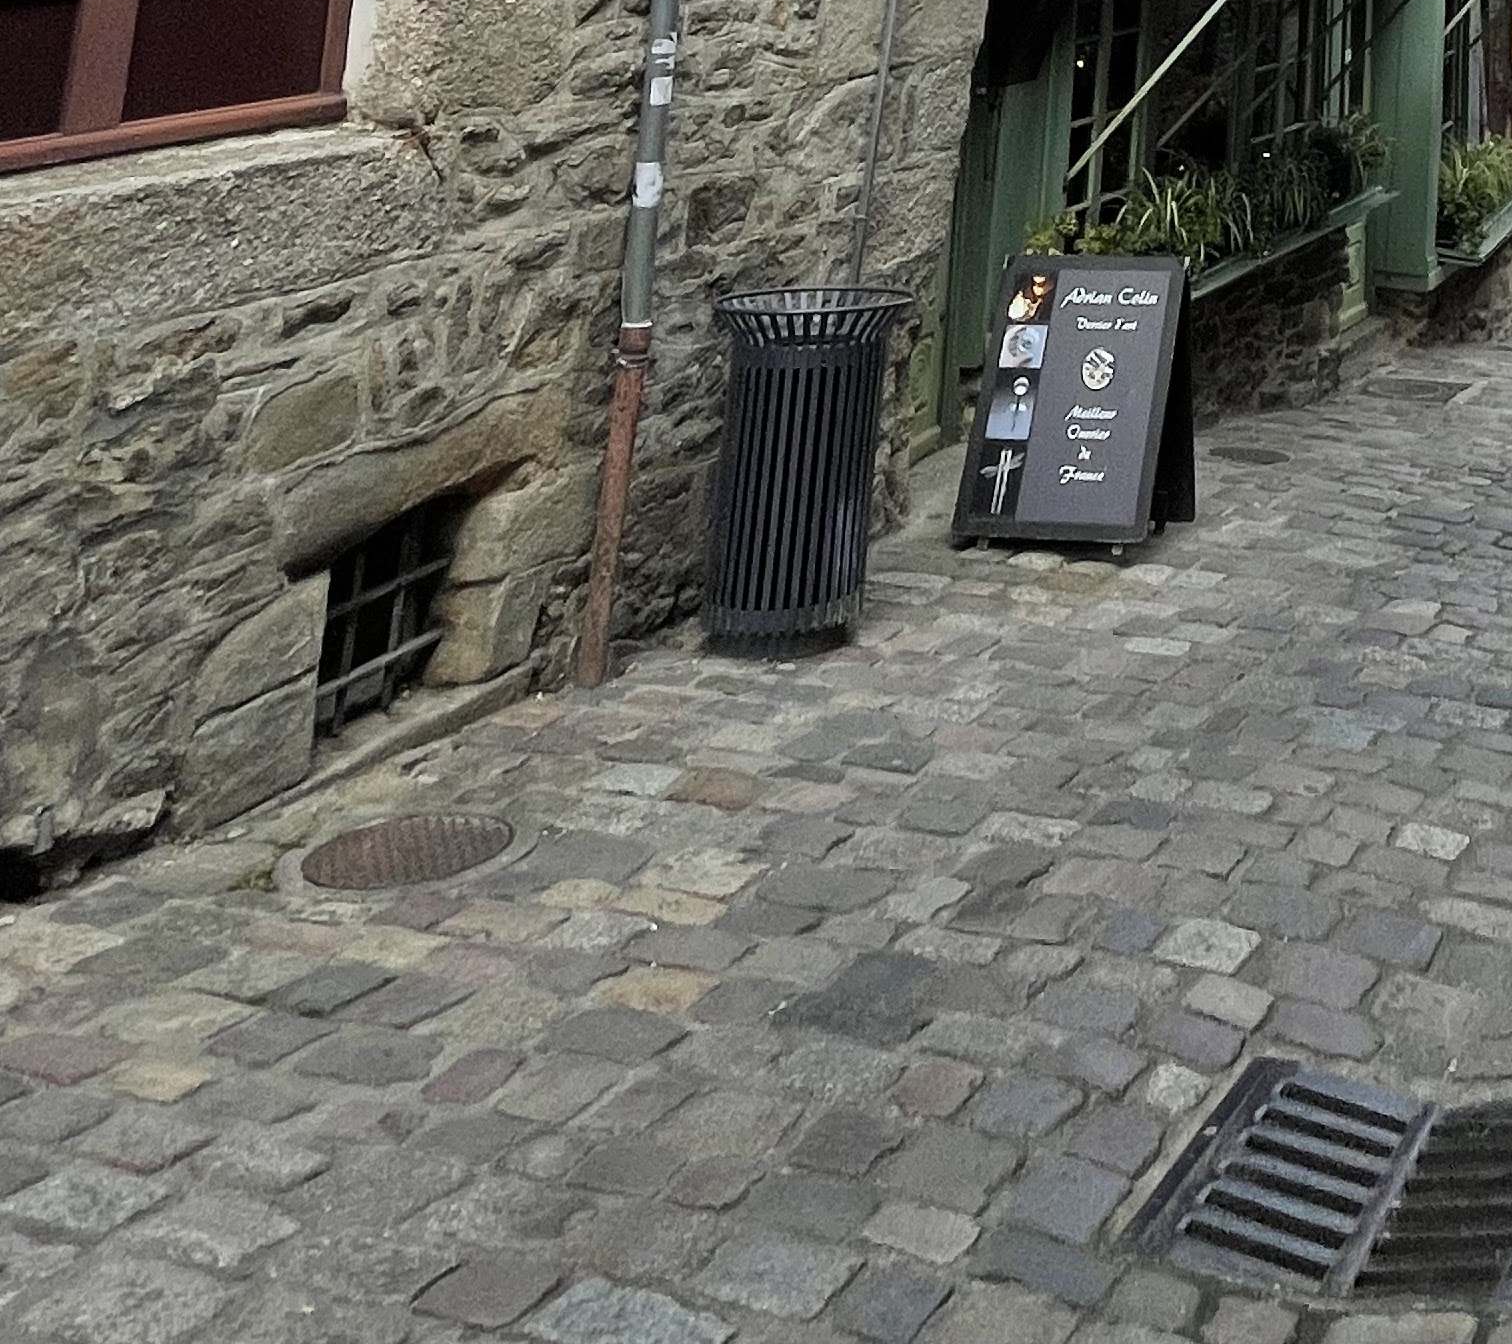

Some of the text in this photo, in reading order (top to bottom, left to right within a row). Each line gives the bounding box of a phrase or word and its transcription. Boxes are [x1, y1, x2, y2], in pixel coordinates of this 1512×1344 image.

[1060, 287, 1159, 308] Adrian Colin
[1059, 465, 1105, 485] France
